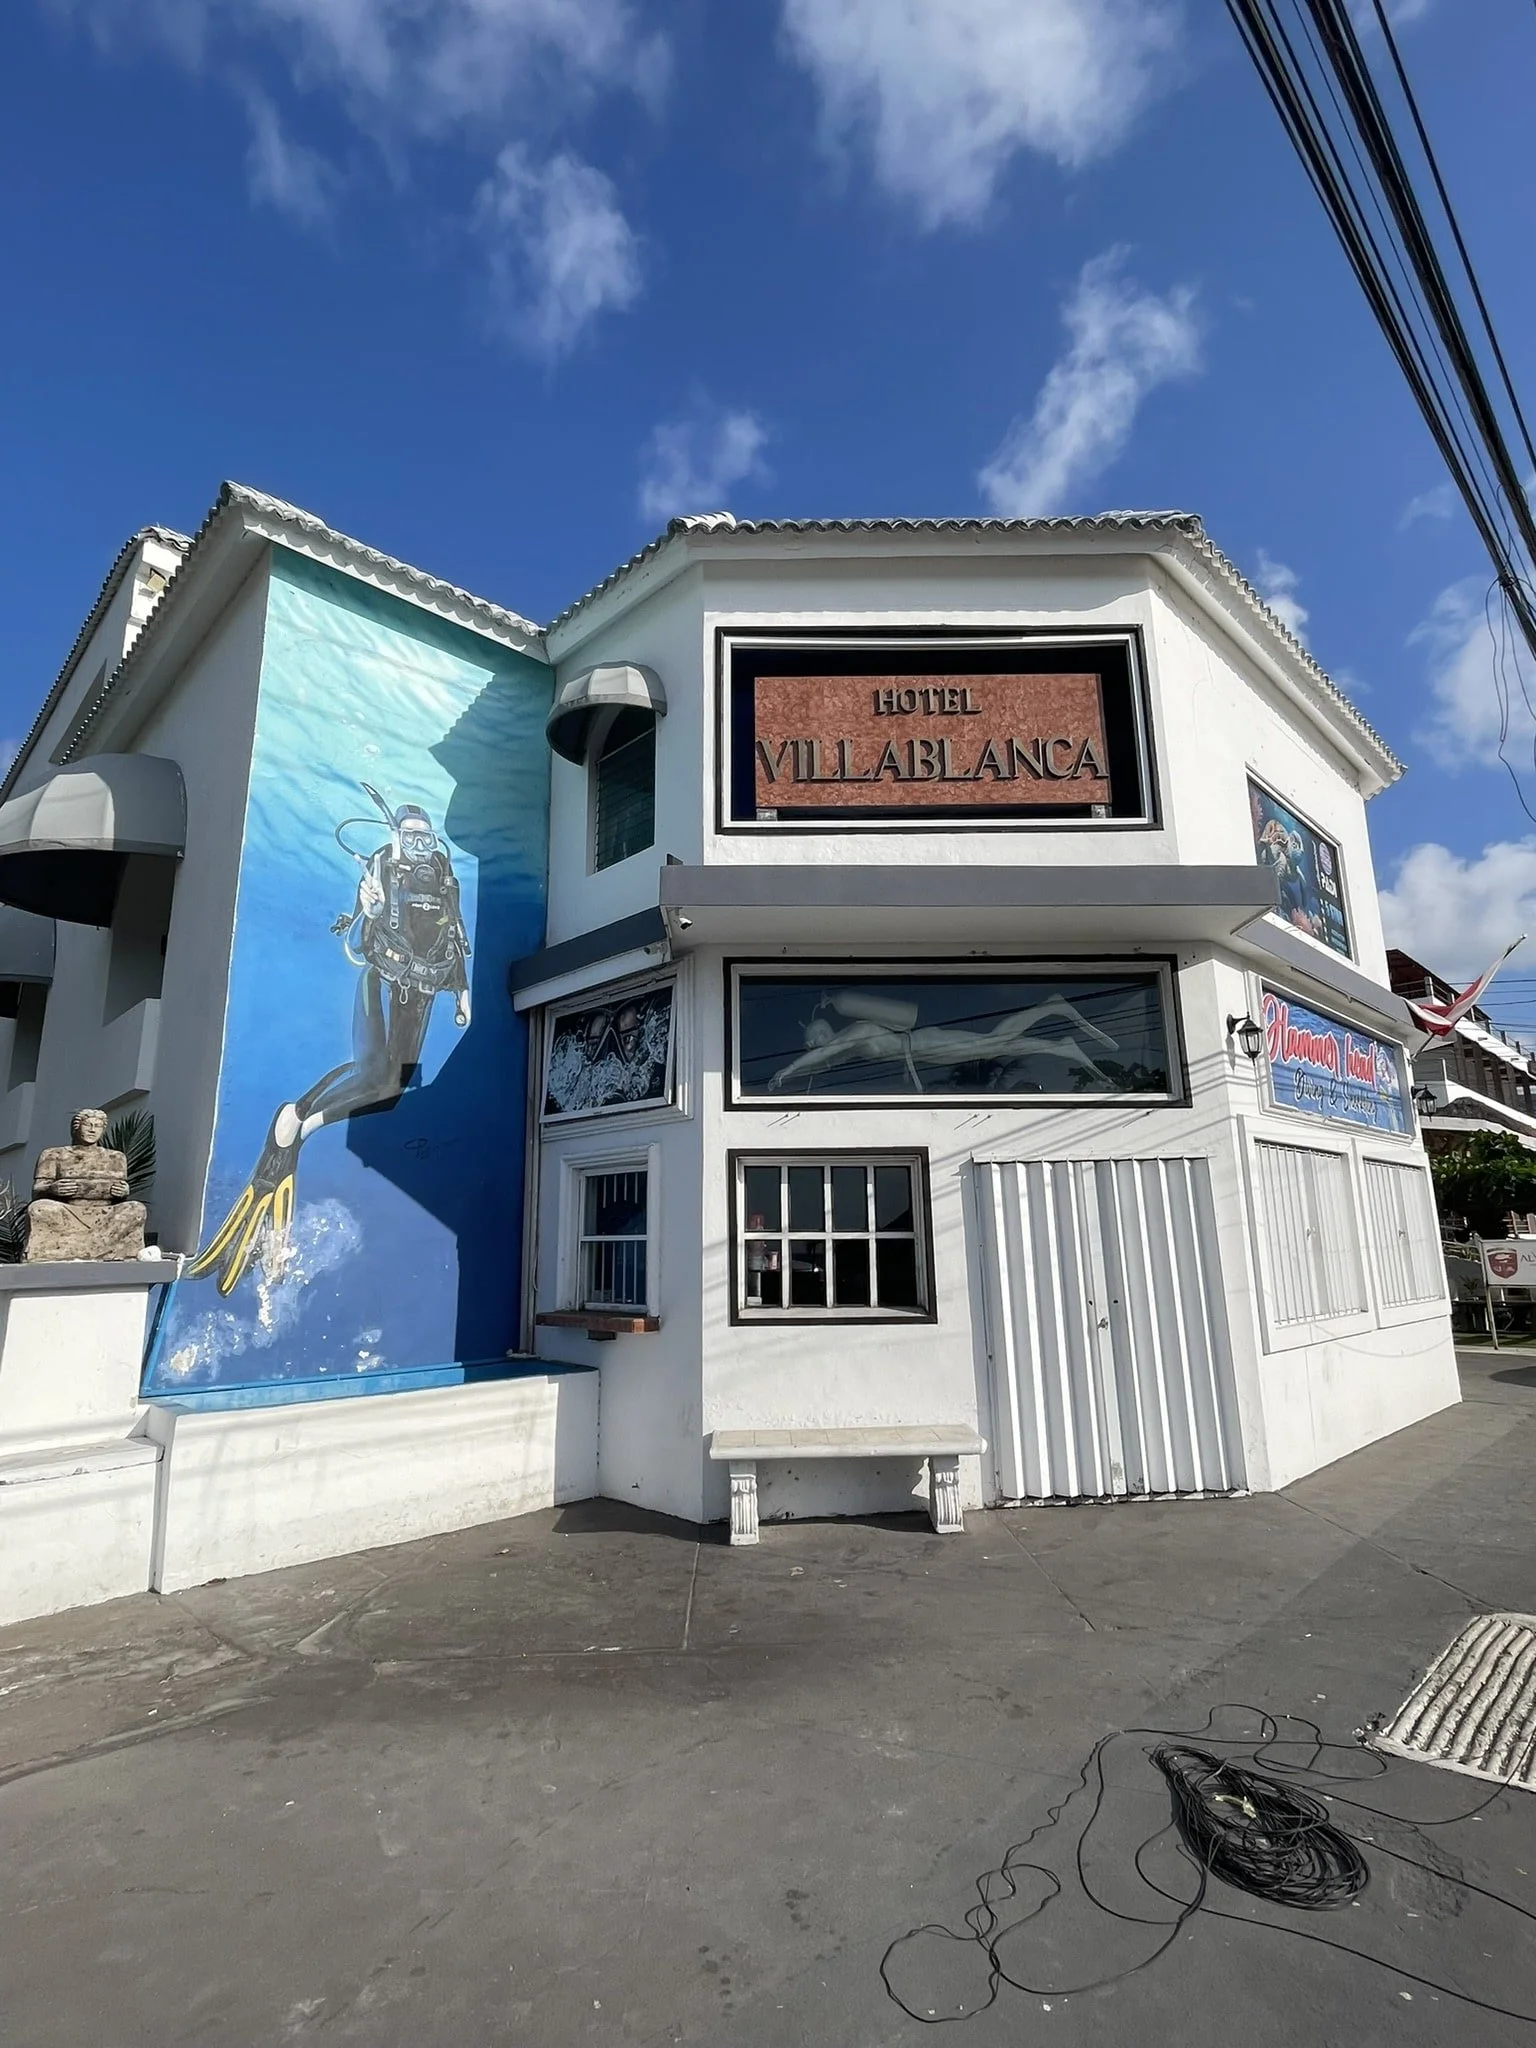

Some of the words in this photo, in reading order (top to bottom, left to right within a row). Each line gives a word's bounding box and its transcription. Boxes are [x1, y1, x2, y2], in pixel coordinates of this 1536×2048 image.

[874, 687, 982, 716] HOTEL
[756, 737, 1110, 783] VILLABLANCA
[1263, 993, 1342, 1081] Hammer
[1345, 1033, 1378, 1091] head
[1294, 1067, 1324, 1110] Diving
[1328, 1079, 1338, 1110] &
